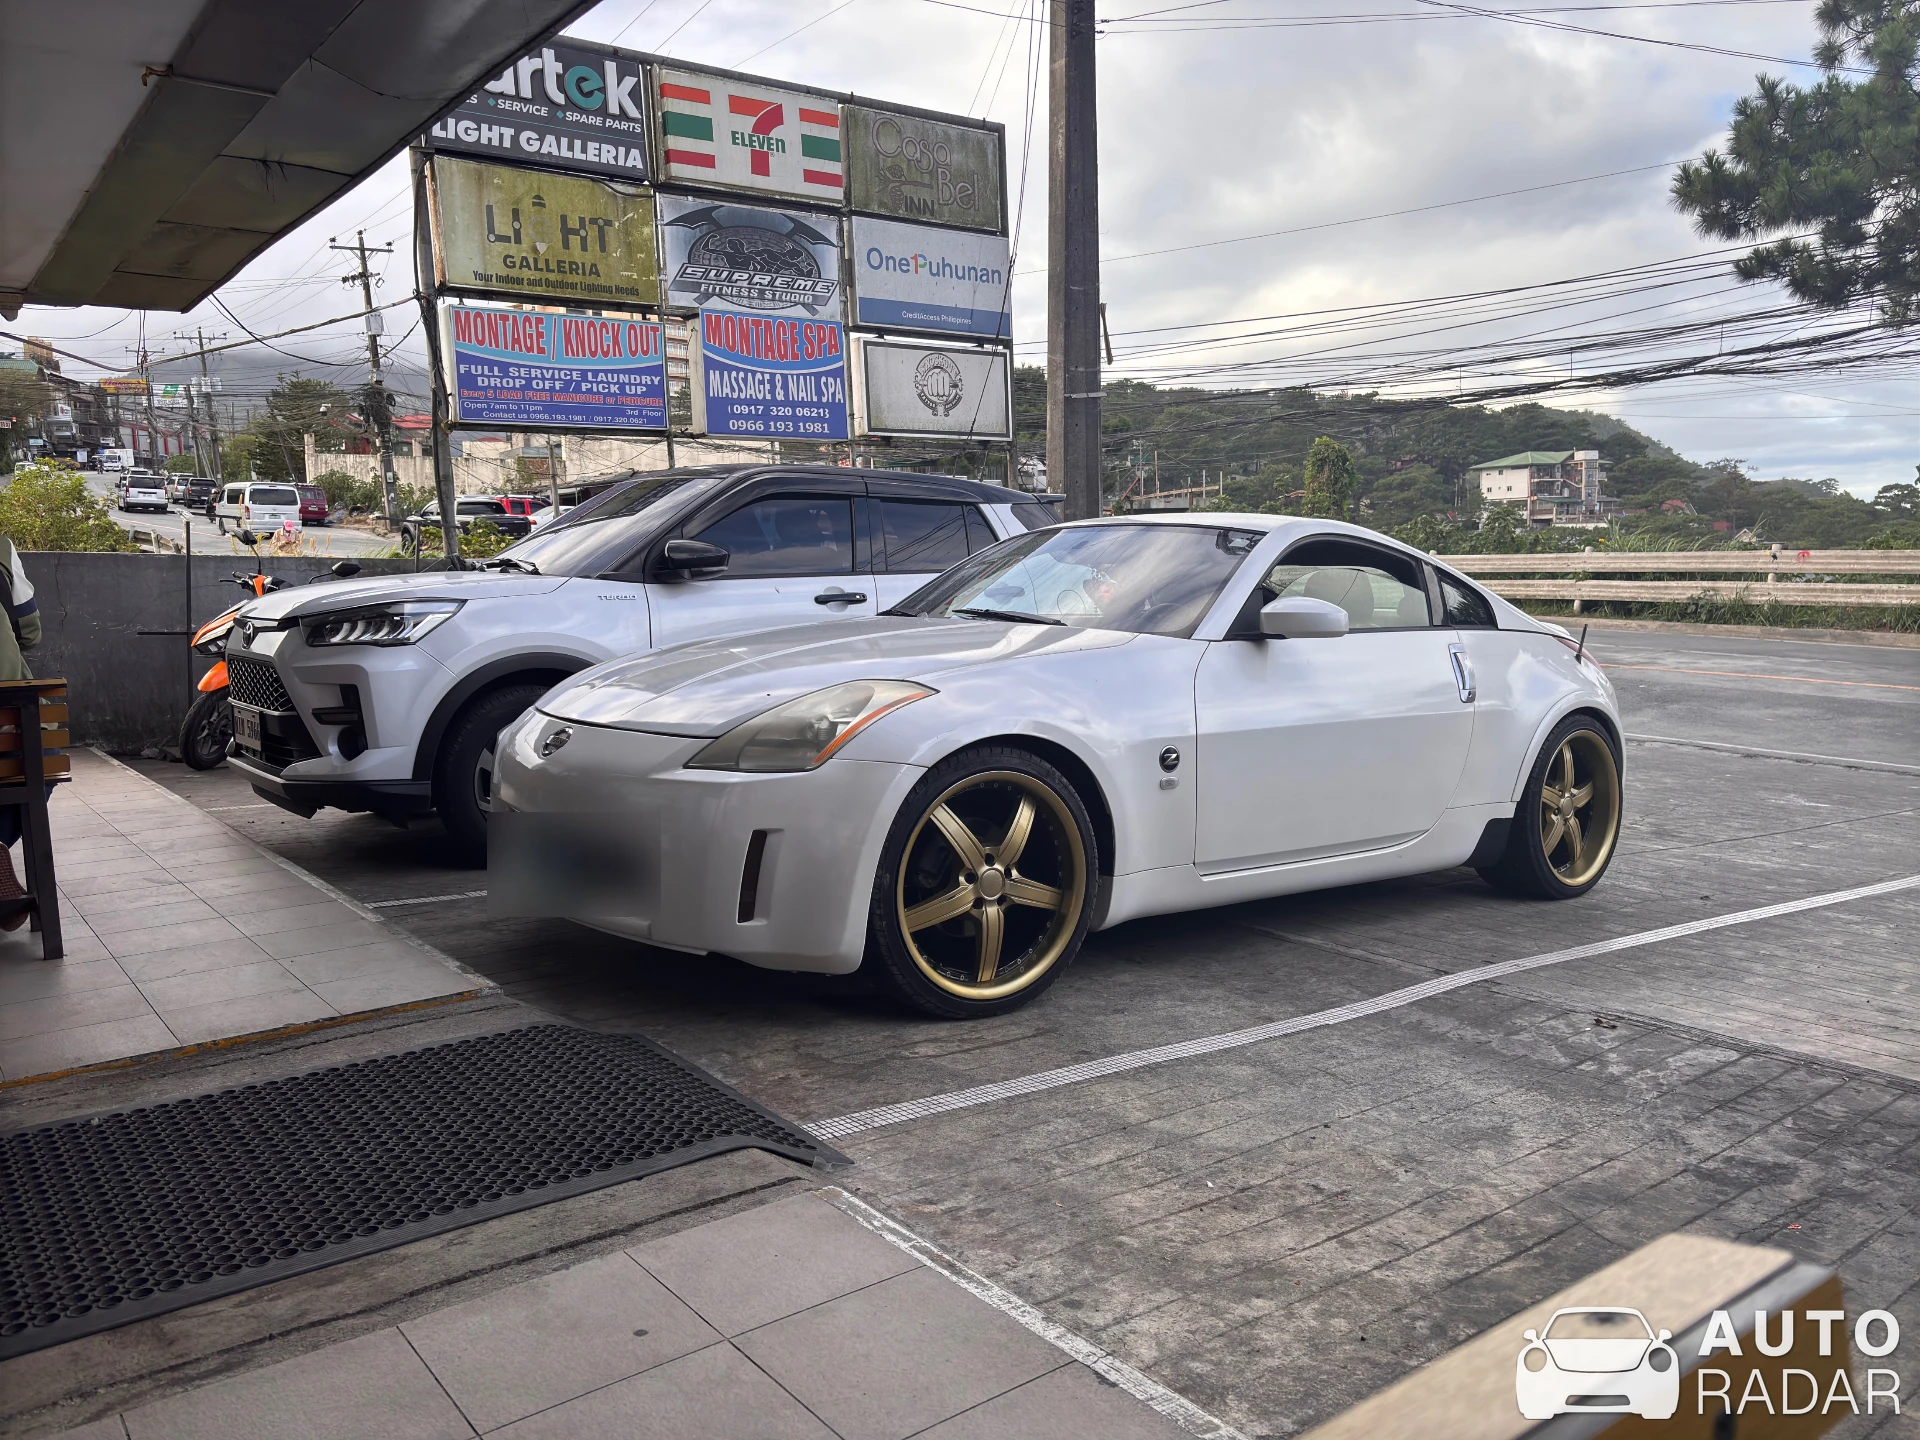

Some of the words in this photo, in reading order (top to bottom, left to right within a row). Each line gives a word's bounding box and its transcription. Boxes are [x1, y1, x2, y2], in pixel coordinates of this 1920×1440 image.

[497, 99, 549, 117] SERVICE
[565, 111, 603, 127] SPARE
[605, 119, 642, 133] PARTS
[431, 118, 515, 149] LIGHT
[519, 131, 644, 170] GALLERIA
[871, 116, 952, 174] Casa
[937, 167, 980, 212] Bel
[904, 195, 935, 217] INN
[502, 254, 601, 278] GALLERIA
[472, 270, 493, 284] Your
[495, 272, 525, 287] Indoor
[526, 275, 543, 288] and
[544, 279, 578, 292] Outdoor
[580, 281, 613, 296] Lighting
[614, 284, 640, 297] Needs
[679, 265, 835, 294] SUPREME
[700, 283, 759, 297] FITNESS
[764, 290, 813, 304] STUDIO
[901, 310, 941, 322] CreditAccess
[941, 314, 972, 325] Philippines
[452, 309, 547, 356] MONTAGE
[561, 318, 624, 359] KNOCK
[626, 322, 661, 358] OUT
[704, 312, 800, 362] MONTAGE
[802, 321, 841, 361] SPA
[459, 364, 503, 376] FULL
[508, 367, 582, 381] SERVICE
[587, 371, 662, 386] LAUNDRY
[477, 377, 526, 389] DROP
[532, 379, 565, 391] OFF
[581, 382, 621, 394] PICK
[625, 385, 648, 395] UP
[709, 369, 772, 400] MASSAGE
[775, 373, 785, 401] &
[788, 374, 818, 402] NAIL
[820, 375, 844, 403] SPA
[461, 389, 485, 399] Every
[487, 389, 494, 399] 5
[497, 390, 523, 400] LOAD
[525, 391, 551, 401] FREE
[553, 392, 604, 404] MANICURE
[605, 396, 616, 404] or
[617, 396, 664, 407] PEDICURE
[464, 401, 488, 410] Open
[489, 402, 507, 410] 7am
[520, 404, 543, 412] 11pm
[482, 411, 516, 419] Contact
[769, 406, 793, 416] 320
[729, 419, 765, 431] 0966
[768, 421, 794, 432] 193
[797, 422, 830, 434] 1981
